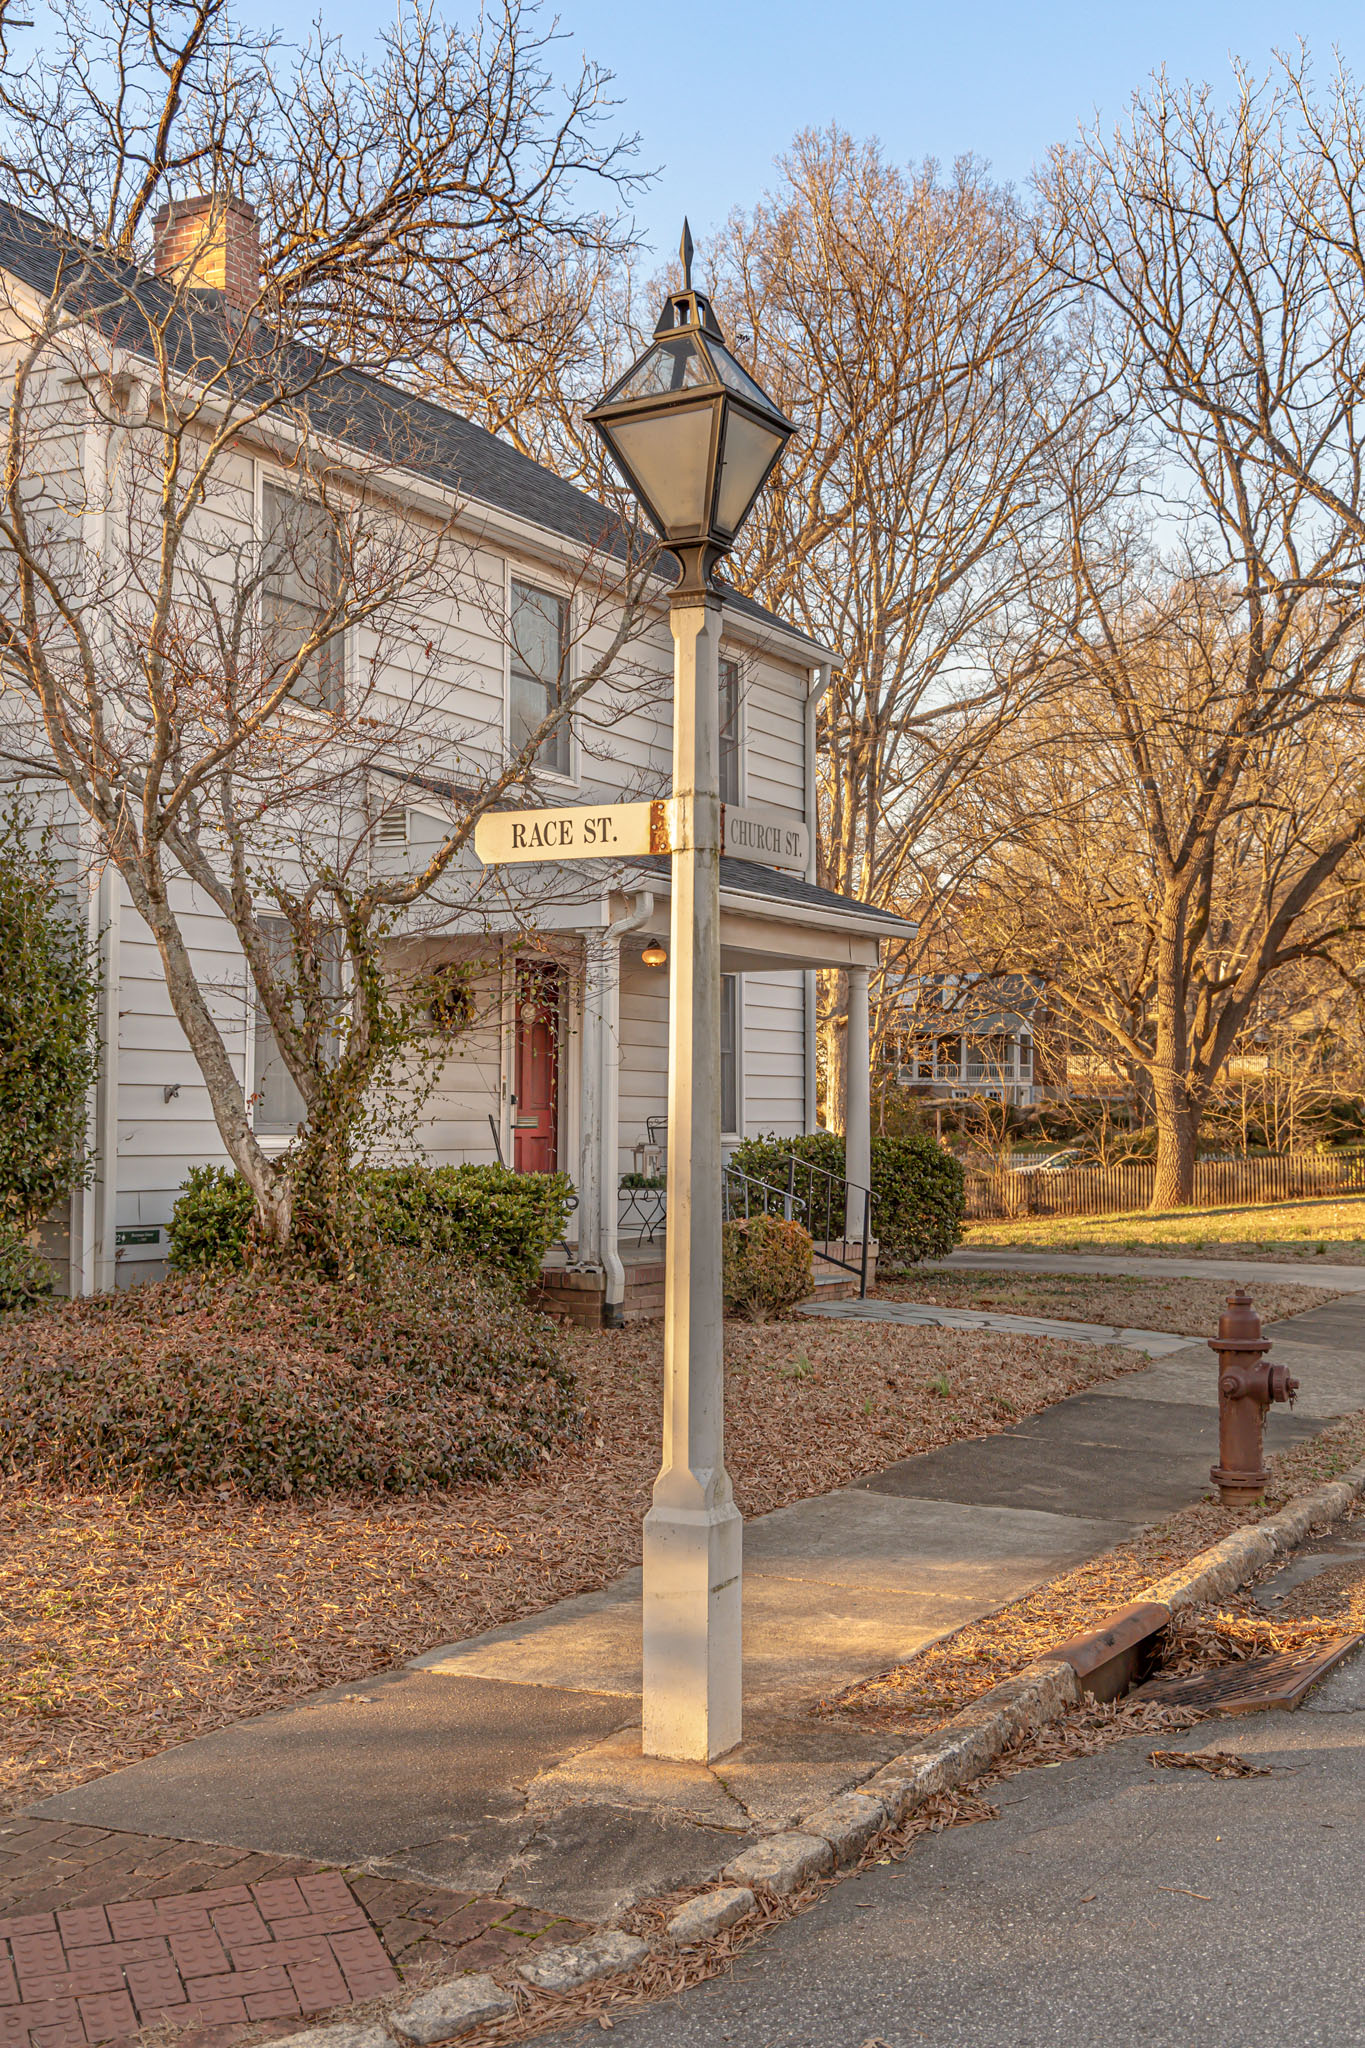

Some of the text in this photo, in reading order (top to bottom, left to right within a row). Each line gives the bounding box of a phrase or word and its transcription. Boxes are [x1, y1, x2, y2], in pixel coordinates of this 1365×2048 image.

[512, 817, 618, 849] RACE ST.
[730, 818, 803, 858] CHURCH ST.
